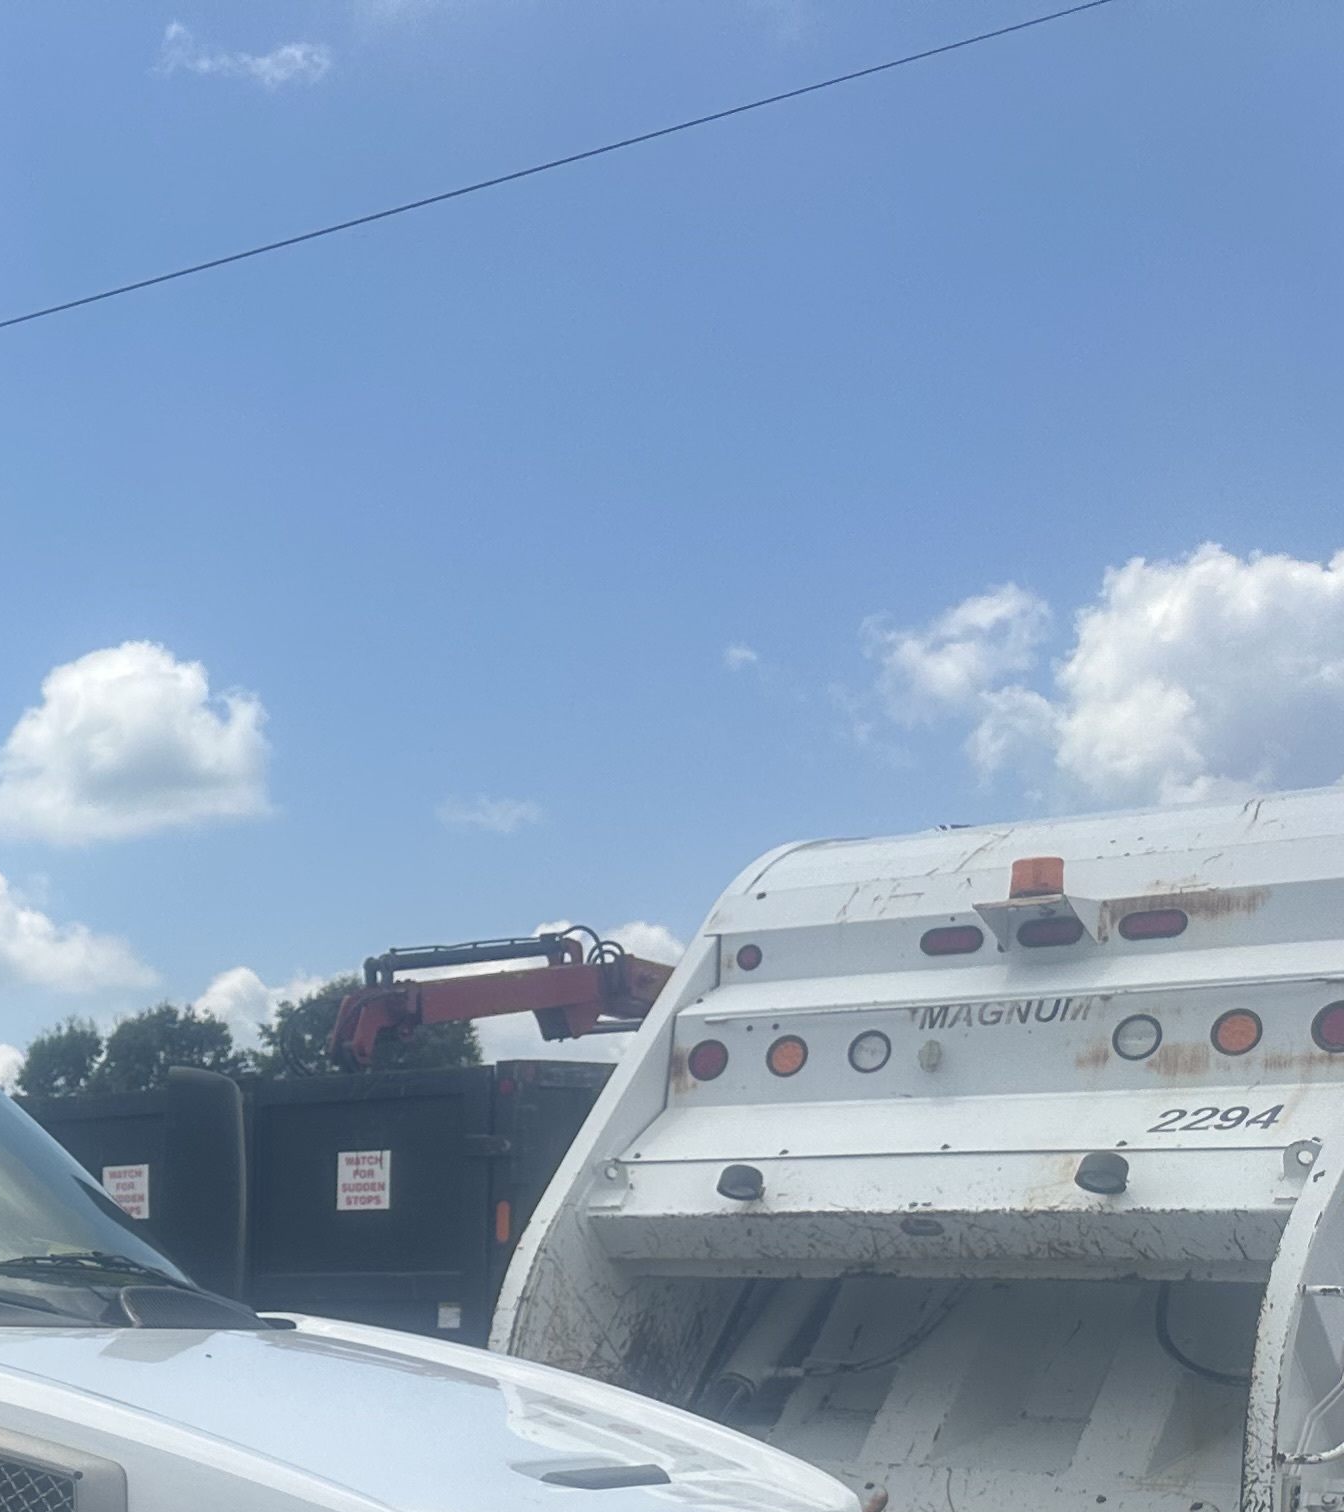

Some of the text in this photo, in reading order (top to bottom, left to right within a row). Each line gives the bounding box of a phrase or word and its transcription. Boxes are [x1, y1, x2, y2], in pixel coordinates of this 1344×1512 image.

[919, 999, 1091, 1030] MAGNUM
[1146, 1104, 1284, 1133] 2294
[344, 1155, 384, 1166] WATCH
[352, 1169, 375, 1180] FOR
[341, 1182, 385, 1193] SUDDEN
[345, 1195, 382, 1206] STOPS
